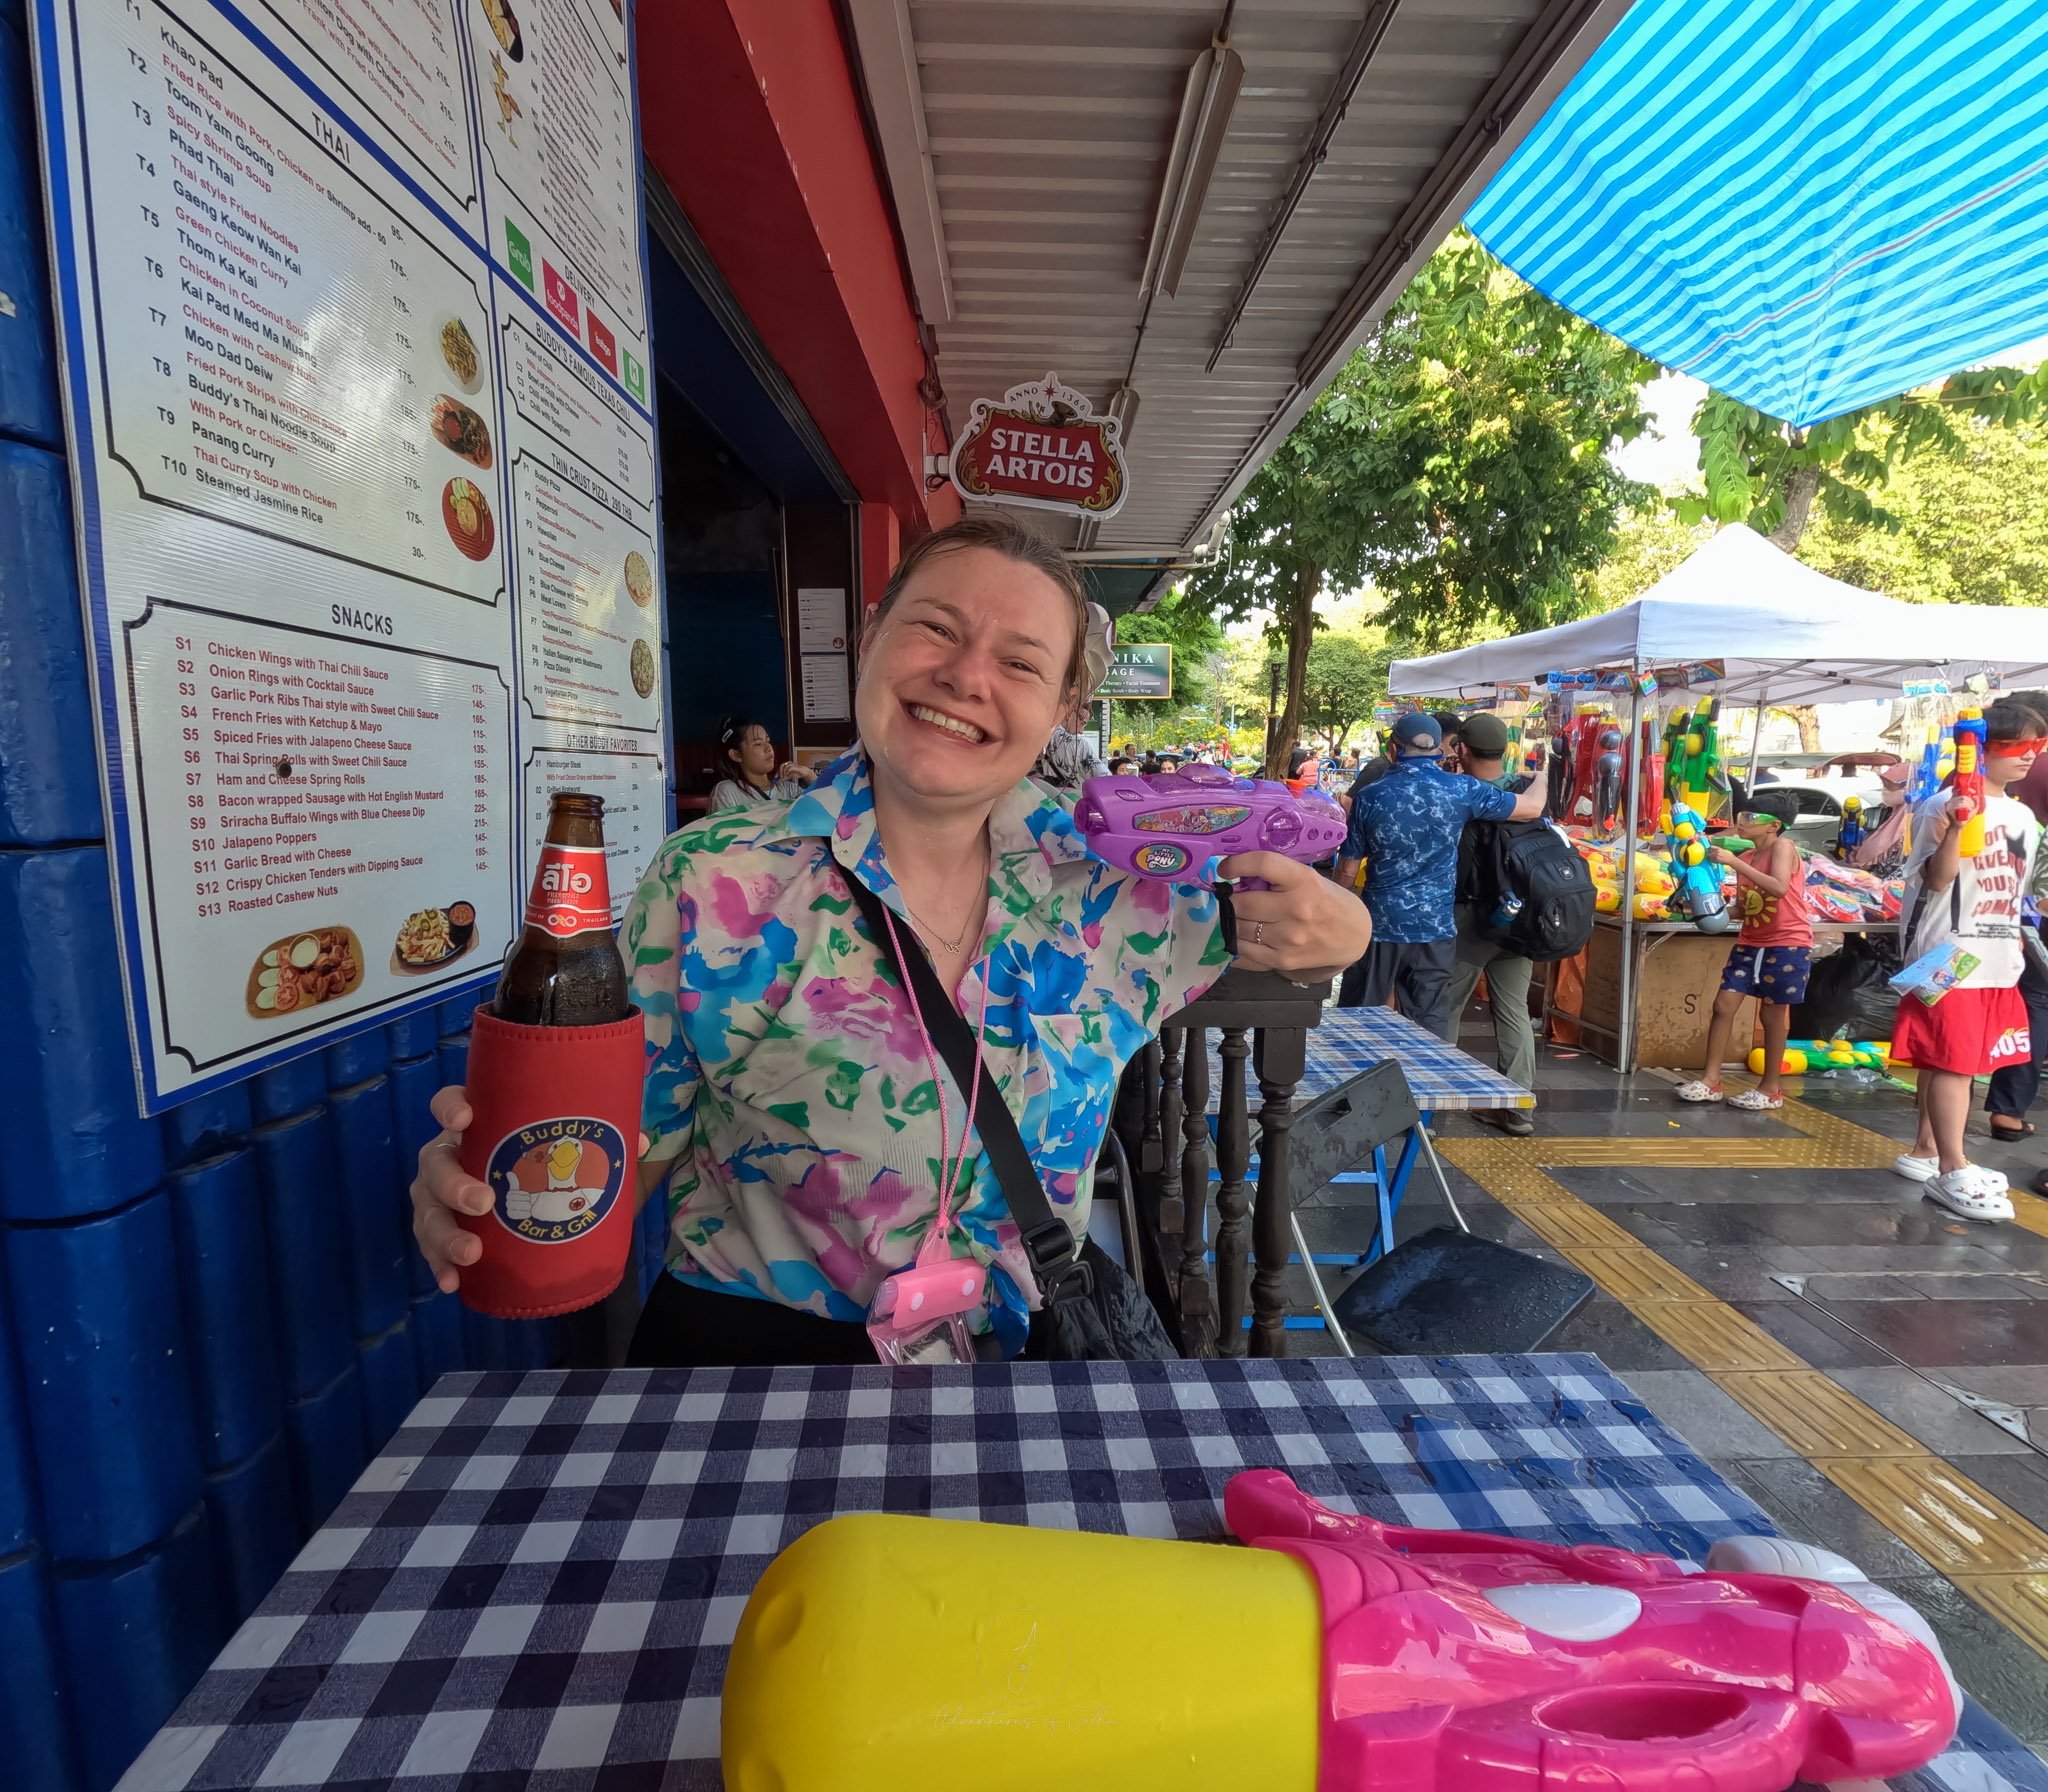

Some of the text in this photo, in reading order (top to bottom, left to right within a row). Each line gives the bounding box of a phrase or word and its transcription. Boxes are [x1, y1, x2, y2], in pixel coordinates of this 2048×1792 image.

[160, 27, 195, 66] Khao
[199, 60, 223, 89] Pad
[336, 17, 354, 45] Dog
[356, 40, 374, 65] with
[127, 47, 273, 176] T2 Toom Yam Goong
[162, 53, 193, 87] Fried
[196, 82, 221, 110] Rice
[223, 107, 246, 130] with
[276, 149, 313, 185] Chicken
[315, 182, 324, 194] or
[326, 189, 355, 220] Shrimp
[357, 216, 371, 233] add
[377, 231, 386, 245] 50
[312, 112, 350, 163] THAI
[136, 153, 301, 275] T4 Gaeng Keow Wan Kai
[509, 240, 531, 273] Grab
[564, 265, 596, 309] DELIVERY
[536, 322, 568, 363] BUDDY'S
[569, 354, 596, 390] FAMOUS
[597, 381, 615, 408] TEXAS
[616, 399, 631, 422] CHILI
[1010, 387, 1087, 412] ANNO 1366
[156, 406, 274, 467] T9 Panang Curry
[989, 428, 1095, 463] STELLA
[161, 455, 322, 523] T10 Steamed Jasmine Rice
[193, 445, 337, 509] Thai Curry Soup with Chicken
[551, 453, 568, 476] THIN
[570, 467, 591, 491] CRUST
[592, 482, 609, 504] PIZZA
[985, 455, 1094, 488] ARTOIS
[331, 604, 394, 636] SNACKS
[175, 636, 388, 680] S1 Chicken Wings with Thai Chili Sauce
[1106, 667, 1135, 676] AGE
[1114, 653, 1154, 664] NIKA
[177, 659, 373, 695] S2 Onion Rings with Cocktail Sauce
[178, 682, 438, 719] S3 Garlic Pork Ribs Thai style with Sweet Chili Sauce
[180, 704, 382, 733] S4 French Fries with Ketchup & Mayo
[182, 727, 411, 750] S5 Spiced Fries with Jalapeno Cheese Sauce
[185, 772, 201, 785] S7
[216, 773, 242, 785] Ham
[245, 773, 265, 785] and
[309, 773, 341, 787] Spring
[343, 773, 365, 784] Rolls
[192, 833, 316, 851] S10 Jalapeno Poppers
[542, 863, 592, 893] ลีโอ
[1147, 854, 1176, 868] PONY
[198, 885, 338, 917] S13 Roasted Cashew Nuts
[520, 1121, 604, 1145] Buddy's
[517, 1209, 598, 1239] Bar & Grill
